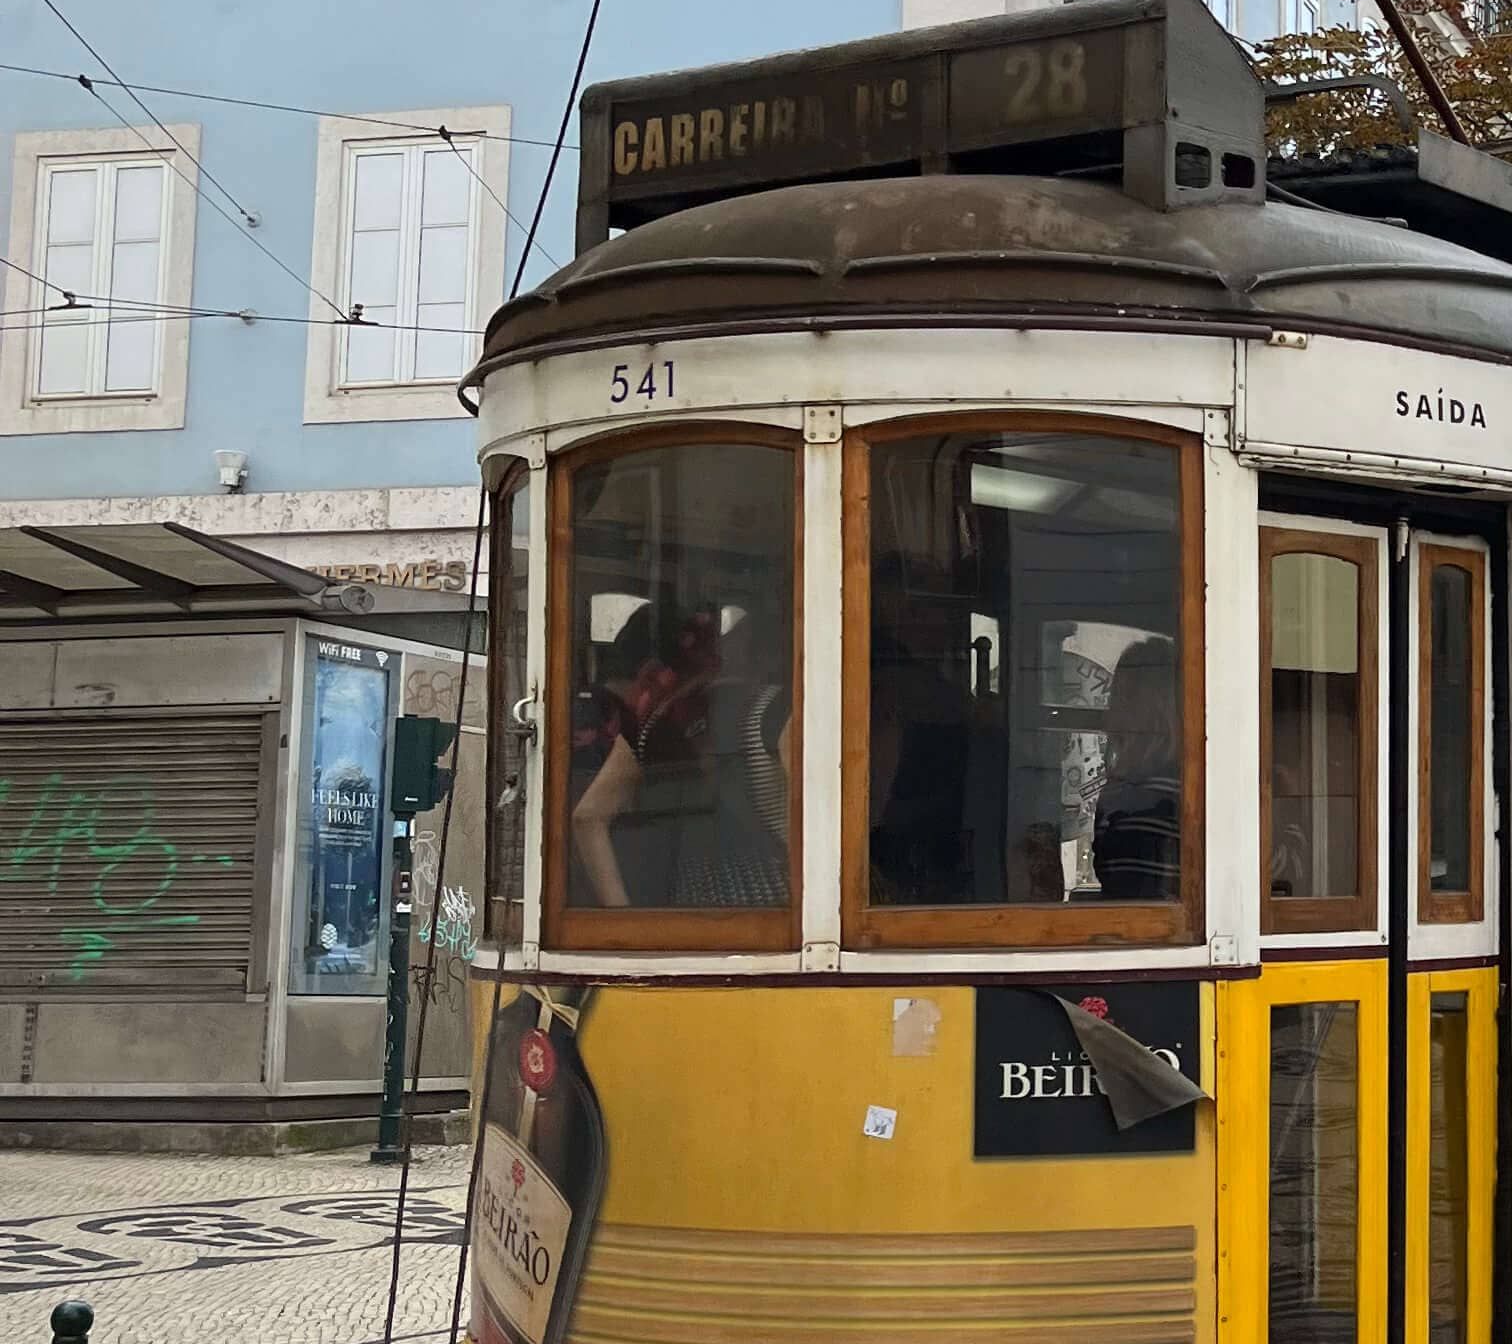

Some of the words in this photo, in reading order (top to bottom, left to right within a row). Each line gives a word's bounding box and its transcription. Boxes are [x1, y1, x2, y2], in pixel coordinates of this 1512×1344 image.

[1004, 41, 1090, 119] 28
[610, 360, 674, 404] 541
[1396, 387, 1487, 429] SAÍDA
[341, 646, 361, 661] FREE
[311, 788, 351, 806] FEELS
[352, 791, 379, 809] LIKE
[328, 807, 365, 826] HOME
[482, 1175, 550, 1286] BEIRÃO
